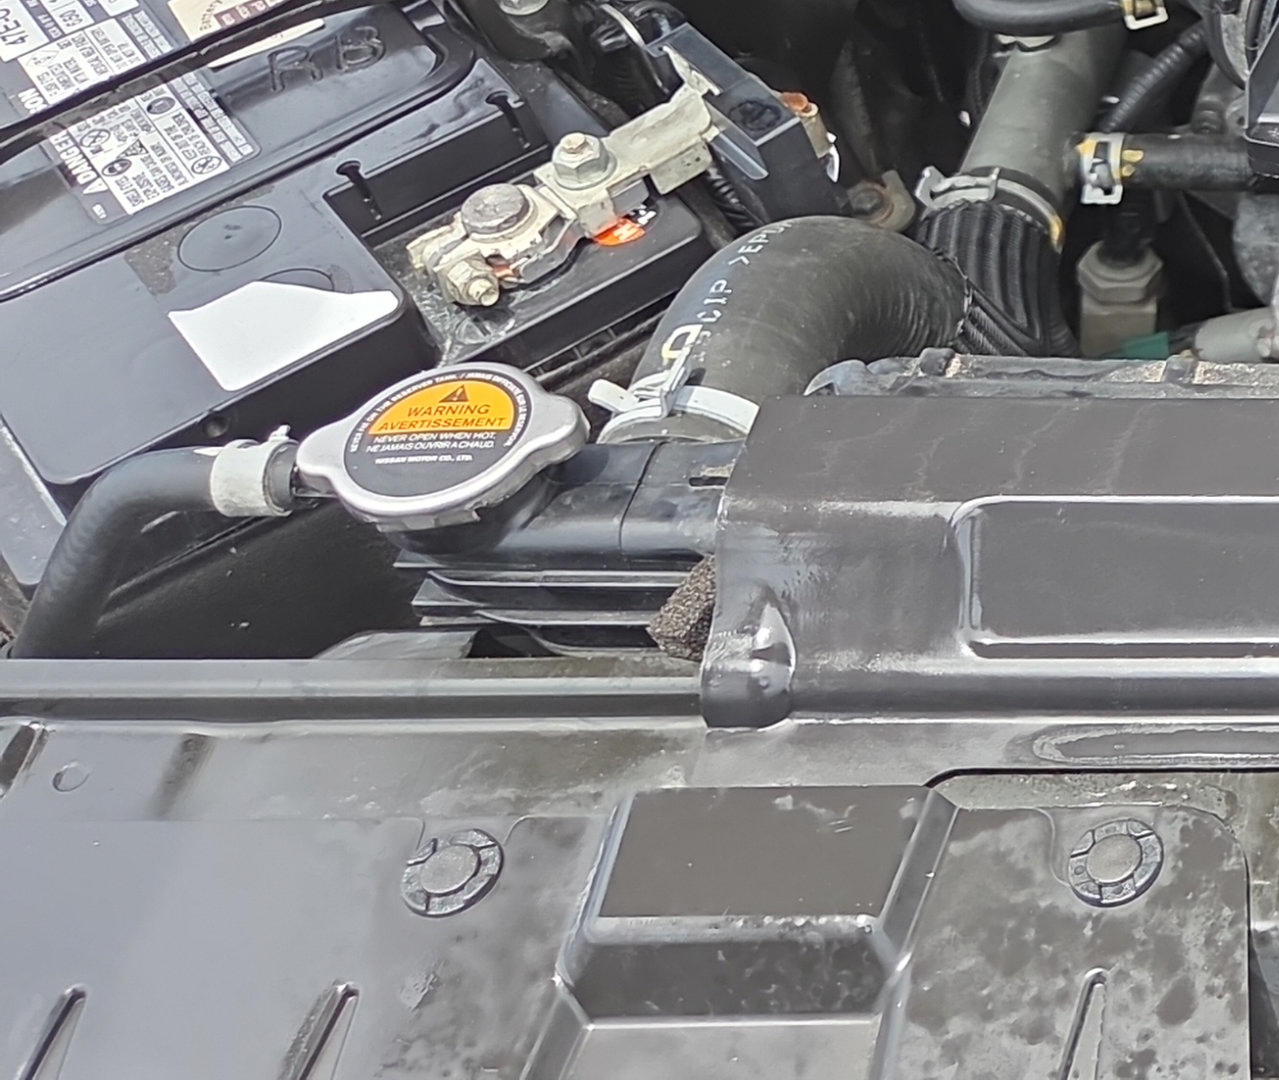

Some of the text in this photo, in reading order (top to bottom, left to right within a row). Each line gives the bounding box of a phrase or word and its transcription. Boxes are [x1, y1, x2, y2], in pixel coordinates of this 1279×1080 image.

[45, 128, 101, 185] DANGER
[407, 404, 491, 417] WARNING
[378, 417, 507, 431] AVERTISSEMENT
[373, 433, 405, 443] NEVER
[408, 432, 438, 440] OPEN
[439, 432, 470, 440] WHEN
